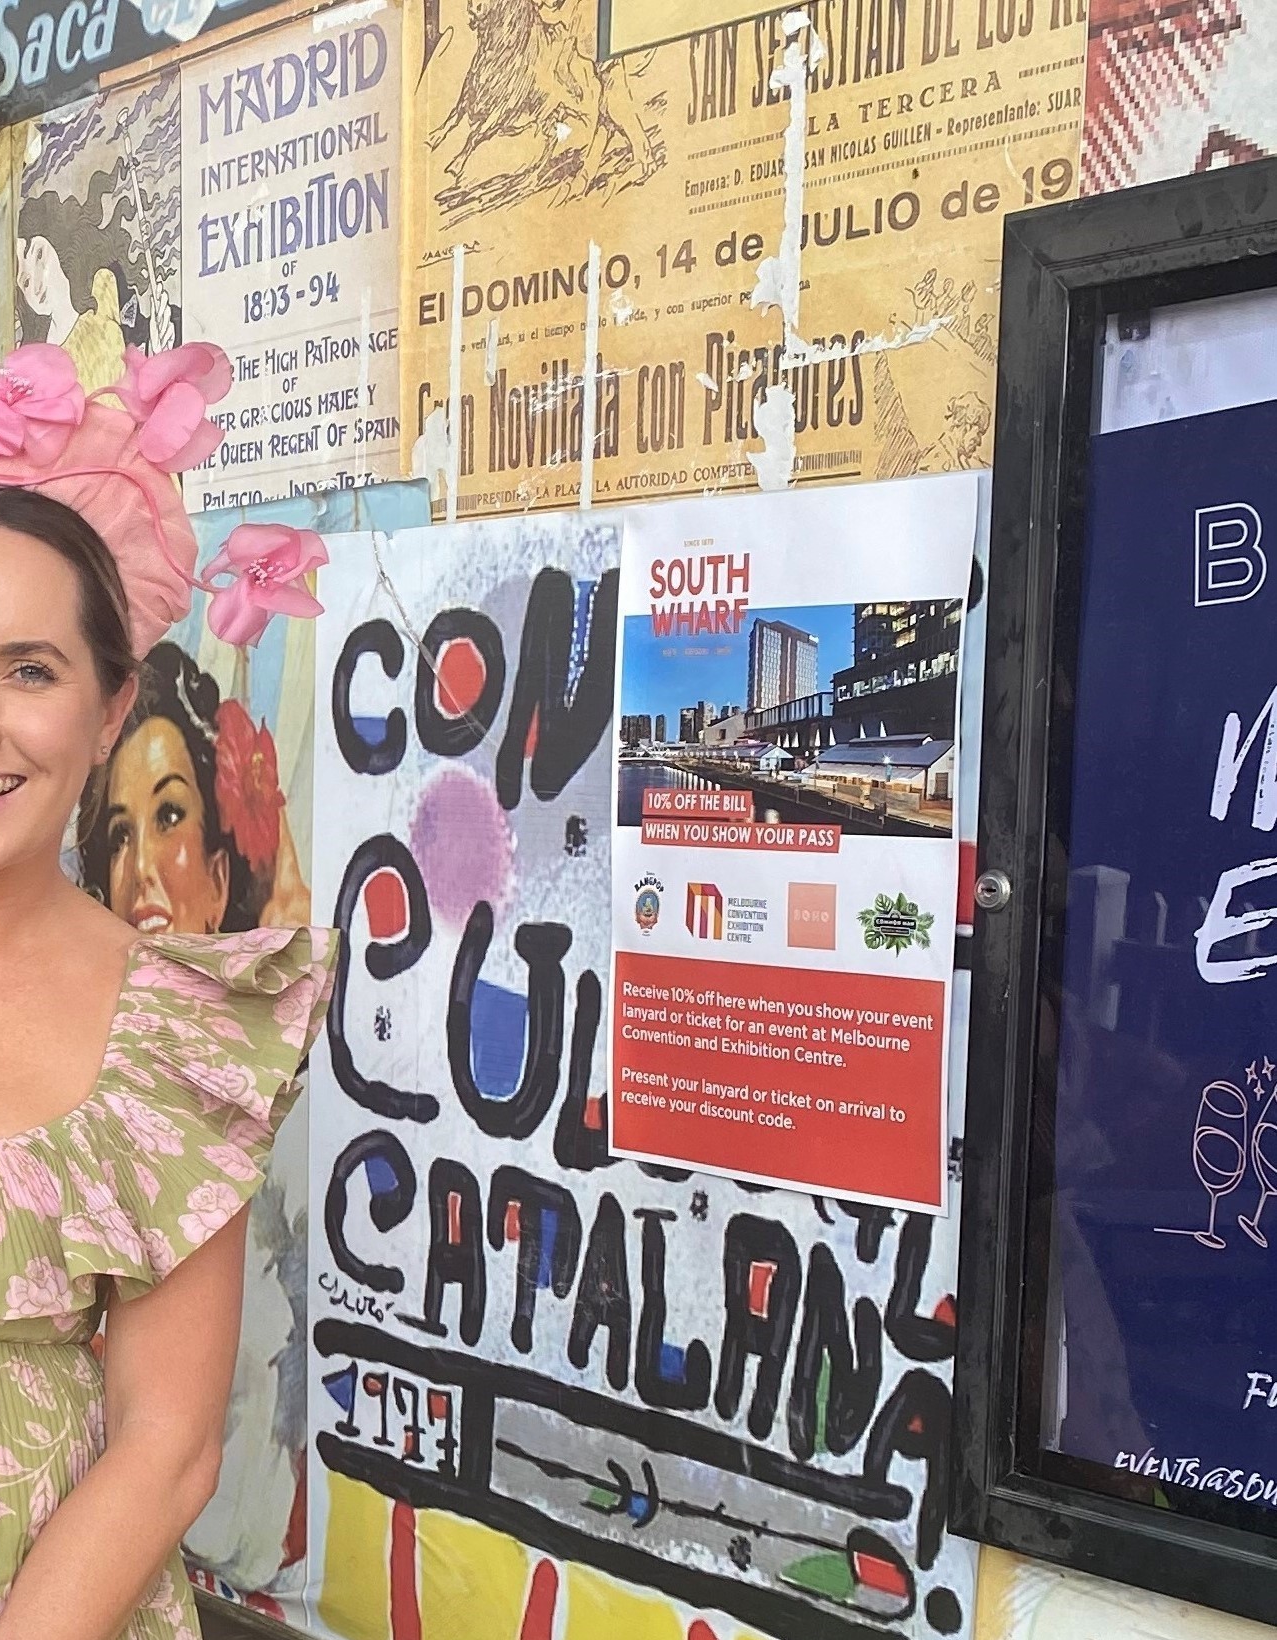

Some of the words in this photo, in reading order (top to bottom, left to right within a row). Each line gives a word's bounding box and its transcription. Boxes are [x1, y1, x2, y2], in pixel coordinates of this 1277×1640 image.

[752, 0, 907, 108] SEASTIAN
[199, 24, 388, 145] MADRID
[807, 113, 839, 137] LA
[859, 70, 1002, 124] TERCERA
[200, 111, 388, 198] INTERNATIONAL
[685, 174, 731, 198] Empresa:
[750, 158, 786, 182] EDUAR
[804, 147, 825, 170] SAN
[830, 135, 877, 164] NICOLAS
[883, 121, 931, 151] GUILLEN
[947, 99, 1040, 137] Representante:
[198, 168, 389, 279] EXHIBITION
[656, 239, 697, 279] 14
[715, 231, 764, 267] de
[800, 190, 921, 251] JULIO
[941, 180, 1000, 220] de
[282, 260, 298, 278] OF
[666, 303, 685, 314] con
[690, 292, 733, 315] superior
[264, 347, 299, 377] HIGH
[282, 376, 299, 394] OF
[317, 383, 377, 416] MAJESY
[636, 361, 685, 454] con
[220, 439, 264, 471] QUEEN
[267, 424, 322, 459] REGENT
[326, 422, 347, 448] OF
[353, 416, 401, 444] SPAIN
[555, 482, 583, 497] PLAZ
[595, 479, 611, 493] LA
[615, 469, 689, 491] AUTORIDAD
[649, 552, 750, 599] SOUTH
[650, 598, 749, 637] WHARF
[648, 792, 672, 809] 10%
[674, 793, 697, 810] OFF
[699, 794, 720, 811] THE
[723, 795, 747, 812] BILL
[645, 822, 680, 840] WHEN
[683, 824, 709, 842] YOU
[712, 825, 752, 843] SHOW
[755, 827, 795, 845] YOUR
[798, 828, 835, 847] PASS
[622, 1002, 667, 1022] lanyard
[669, 1012, 683, 1024] or
[686, 1011, 722, 1030] ticket
[725, 1015, 745, 1032] for
[747, 1021, 765, 1034] an
[768, 1023, 809, 1040] event
[811, 1027, 827, 1042] at
[830, 1027, 911, 1051] Melbourne
[623, 982, 669, 1001] Receive
[670, 987, 695, 1004] 10%
[696, 990, 715, 1005] off
[716, 991, 746, 1010] here
[747, 996, 785, 1014] when
[787, 1002, 813, 1018] you
[815, 1003, 854, 1021] show
[856, 1009, 890, 1025] your
[891, 1013, 934, 1031] event
[622, 1024, 691, 1047] Convention
[694, 1036, 718, 1051] and
[721, 1037, 790, 1061] Exhibition
[794, 1046, 847, 1068] Centre.
[621, 1066, 669, 1088] Present
[671, 1077, 700, 1092] your
[701, 1078, 749, 1100] lanyard
[752, 1089, 768, 1103] or
[770, 1088, 813, 1110] ticket
[815, 1098, 835, 1113] on
[838, 1100, 886, 1120] arrival
[889, 1105, 907, 1123] to
[621, 1090, 666, 1109] receive
[668, 1098, 697, 1113] your
[699, 1100, 755, 1124] discount
[757, 1112, 798, 1130] code.
[321, 1360, 460, 1480] 1977
